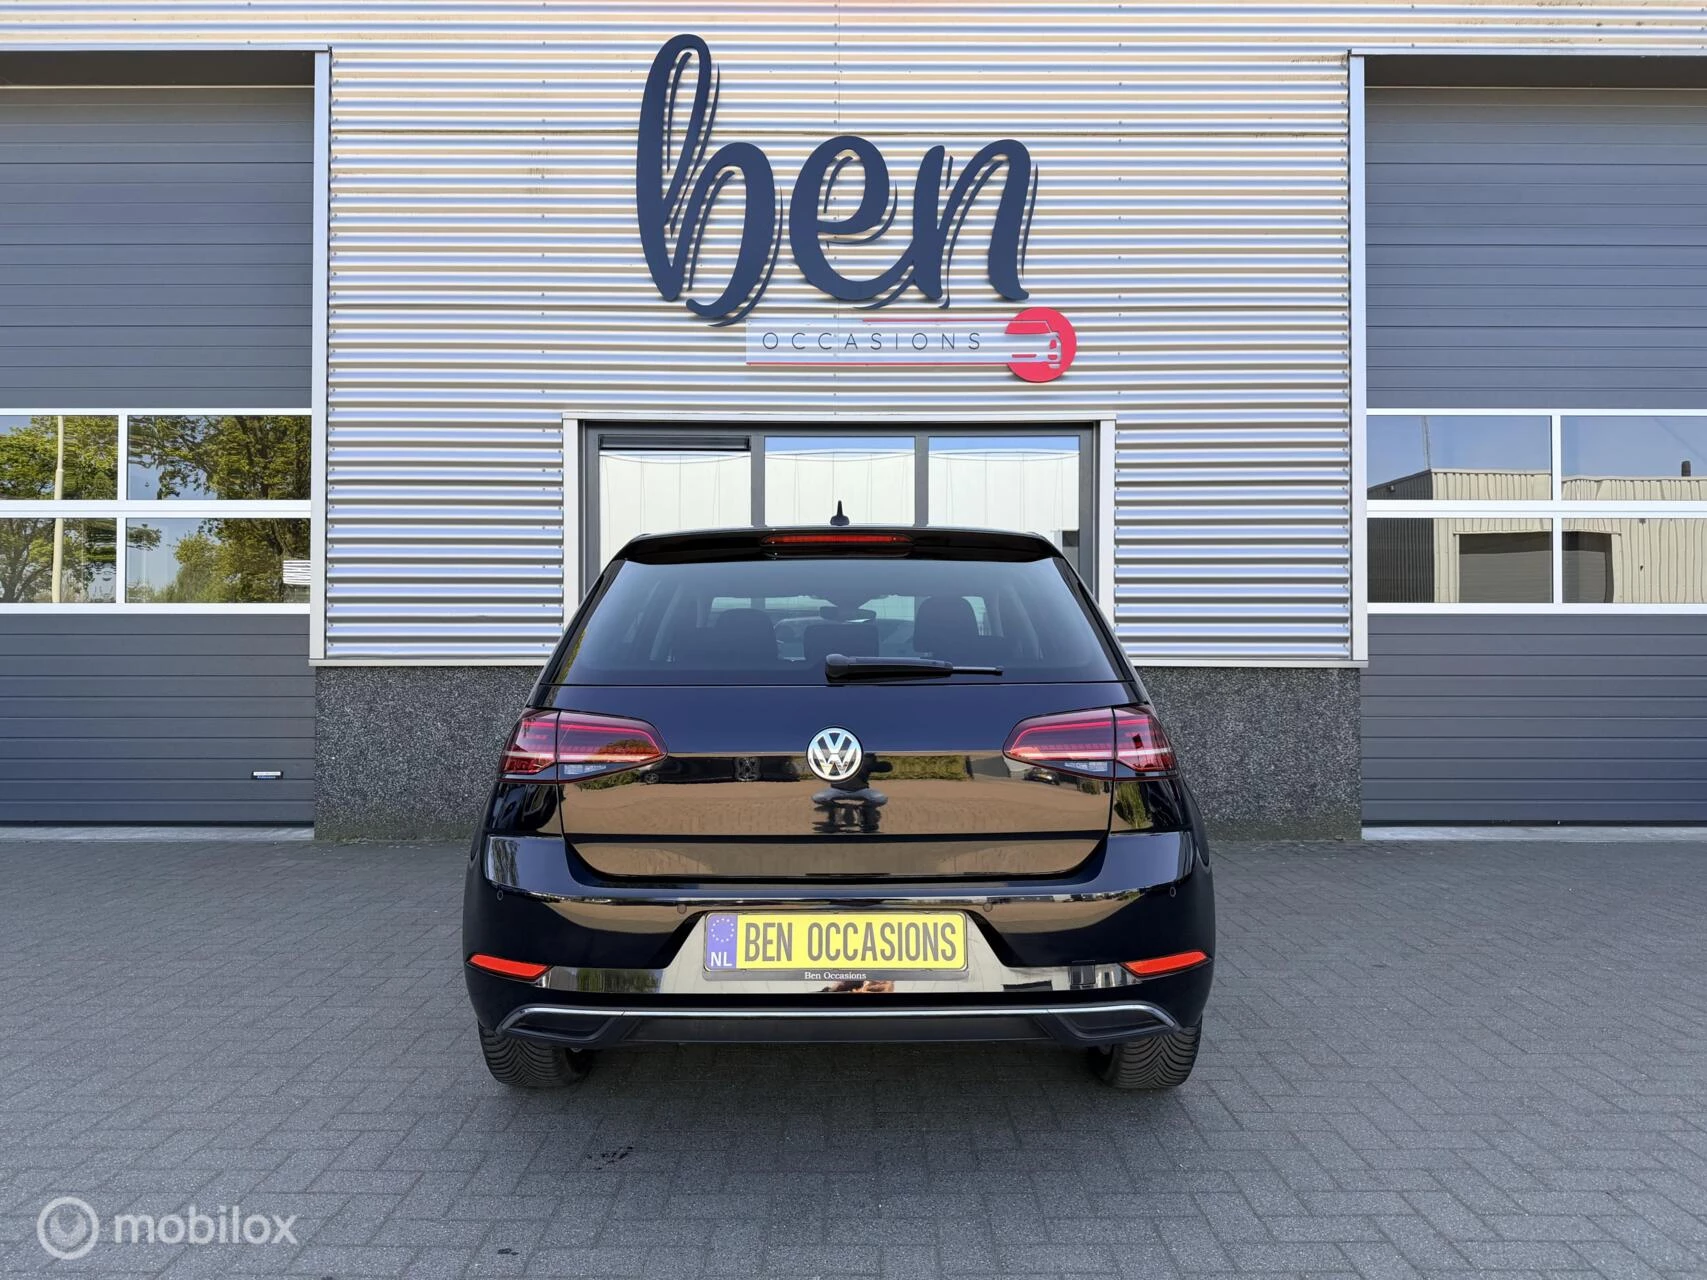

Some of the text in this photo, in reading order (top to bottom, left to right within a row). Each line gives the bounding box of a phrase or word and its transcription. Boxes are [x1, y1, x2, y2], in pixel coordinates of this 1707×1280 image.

[636, 33, 1039, 326] ben
[761, 331, 981, 351] OCCASIONS
[744, 921, 957, 962] BEN OCCASIONS
[710, 951, 733, 967] NL
[804, 971, 867, 980] Ben Occasions
